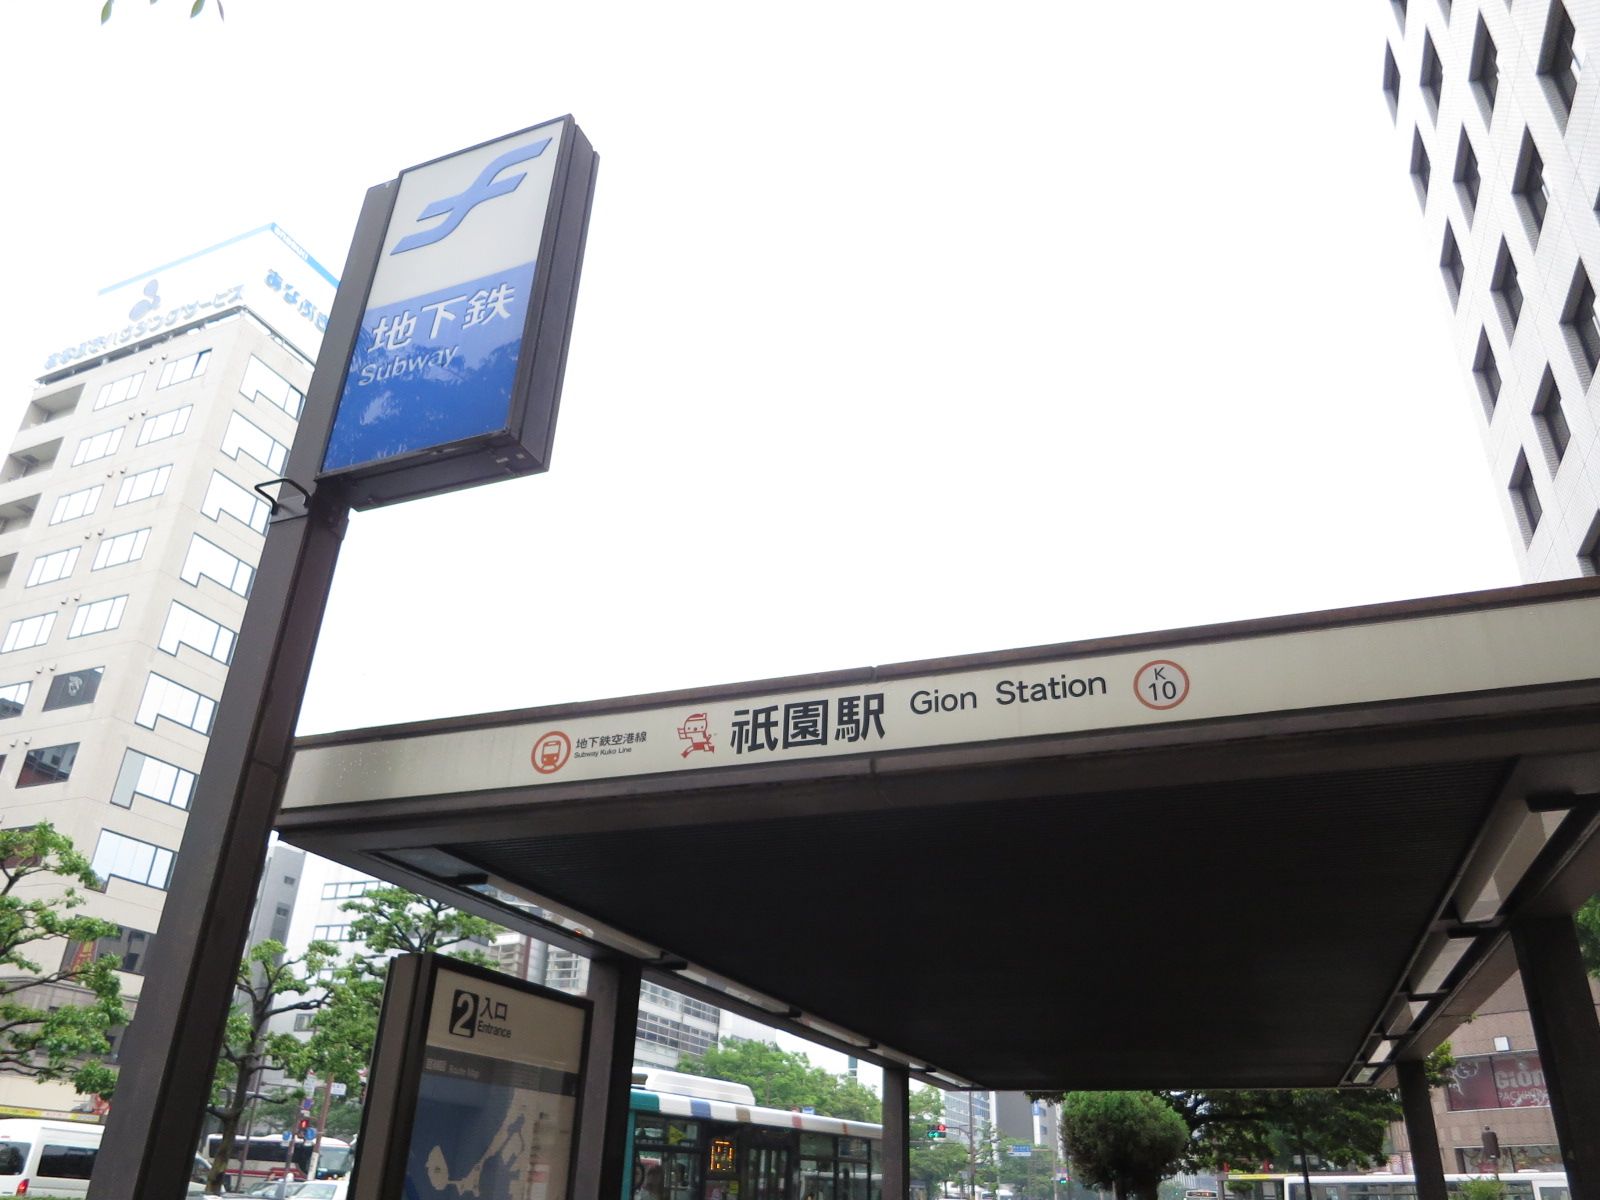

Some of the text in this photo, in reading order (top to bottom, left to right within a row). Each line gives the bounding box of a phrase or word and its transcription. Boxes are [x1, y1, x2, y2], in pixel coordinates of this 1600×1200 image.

[367, 283, 515, 353] 地下鉄
[358, 345, 459, 386] Subway
[1153, 667, 1166, 681] K
[909, 674, 1107, 715] Gion Station
[1148, 680, 1177, 702] 10
[729, 693, 886, 755] 祇園駅
[576, 731, 647, 749] 地下鉄空港線
[574, 746, 632, 759] Subway Kuko Line
[452, 992, 475, 1037] 2
[480, 997, 508, 1021] 入口
[477, 1020, 512, 1039] Entrance
